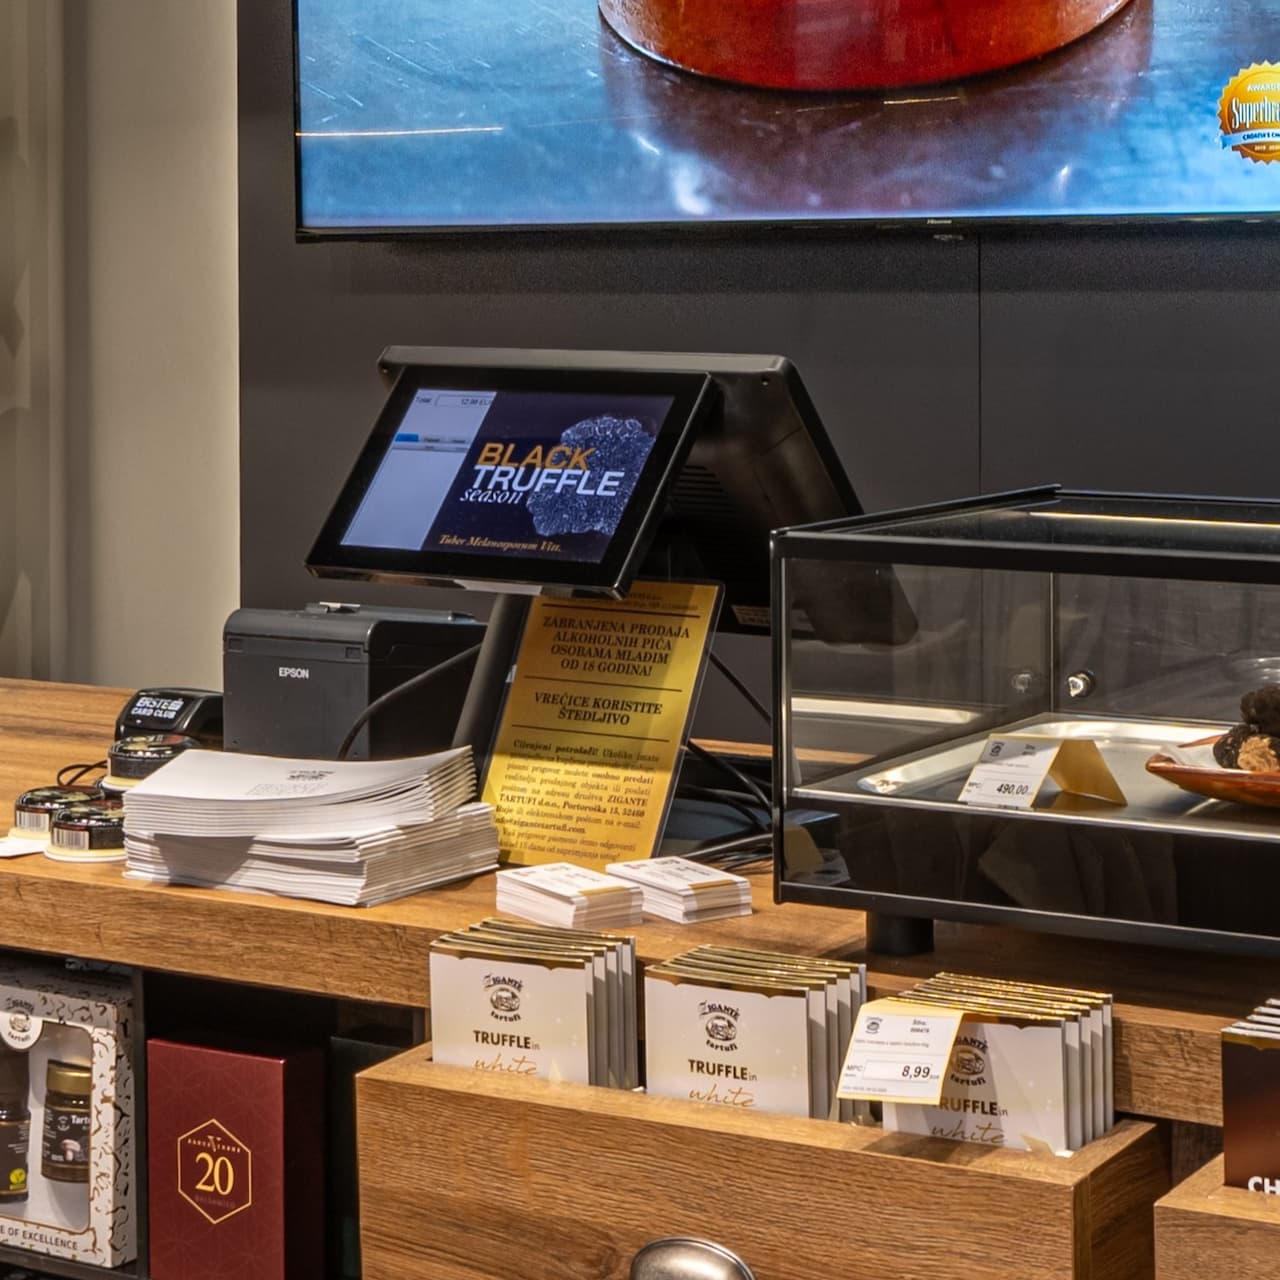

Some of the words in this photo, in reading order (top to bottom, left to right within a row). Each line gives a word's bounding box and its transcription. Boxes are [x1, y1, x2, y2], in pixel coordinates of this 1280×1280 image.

[477, 442, 597, 471] BLACK
[472, 464, 625, 498] TRUFFLE
[460, 486, 523, 505] season
[543, 616, 626, 634] ZABRANJENA
[630, 624, 690, 639] PRODAJA
[553, 631, 637, 648] ALKOHOLNIH
[551, 645, 612, 660] OSOBAMA
[279, 667, 310, 679] EPSON
[561, 658, 577, 669] OD
[582, 660, 595, 671] 18
[597, 663, 653, 677] GODINA!
[593, 698, 664, 715] KORISTITE
[499, 794, 536, 807] TARTUFI
[607, 795, 648, 807] ZIGANTE
[490, 1011, 522, 1022] tartufi
[473, 1030, 531, 1049] TRUFFLE
[706, 1040, 738, 1051] tartufi
[475, 1053, 539, 1075] white
[688, 1059, 748, 1081] TRUFFLE
[902, 1065, 931, 1079] 8,99
[689, 1084, 755, 1108] white
[933, 1099, 998, 1117] RUFFLE
[931, 1119, 1006, 1144] white
[194, 1152, 234, 1196] 20
[7, 1226, 19, 1237] OF
[22, 1228, 78, 1251] EXCELLENCE
